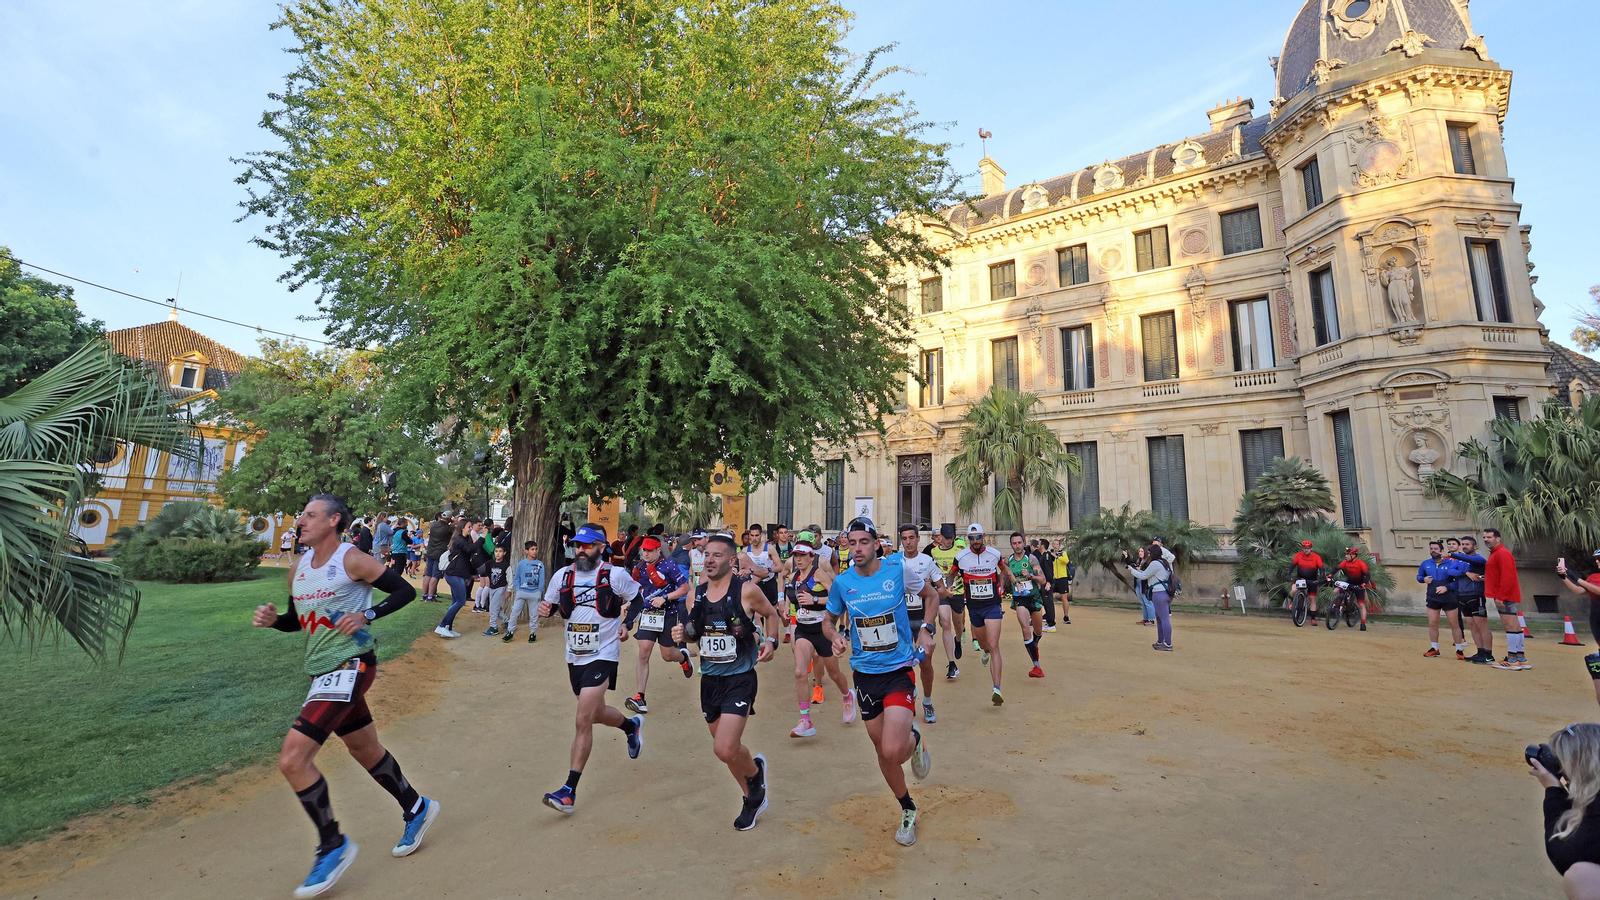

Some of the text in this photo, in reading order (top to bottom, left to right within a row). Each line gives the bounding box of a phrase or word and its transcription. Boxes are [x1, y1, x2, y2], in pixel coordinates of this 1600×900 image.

[975, 585, 988, 593] 124
[850, 594, 894, 605] BENALMADENA
[648, 615, 657, 624] 85
[572, 633, 591, 645] 154
[873, 628, 880, 640] 1
[706, 638, 726, 651] 150
